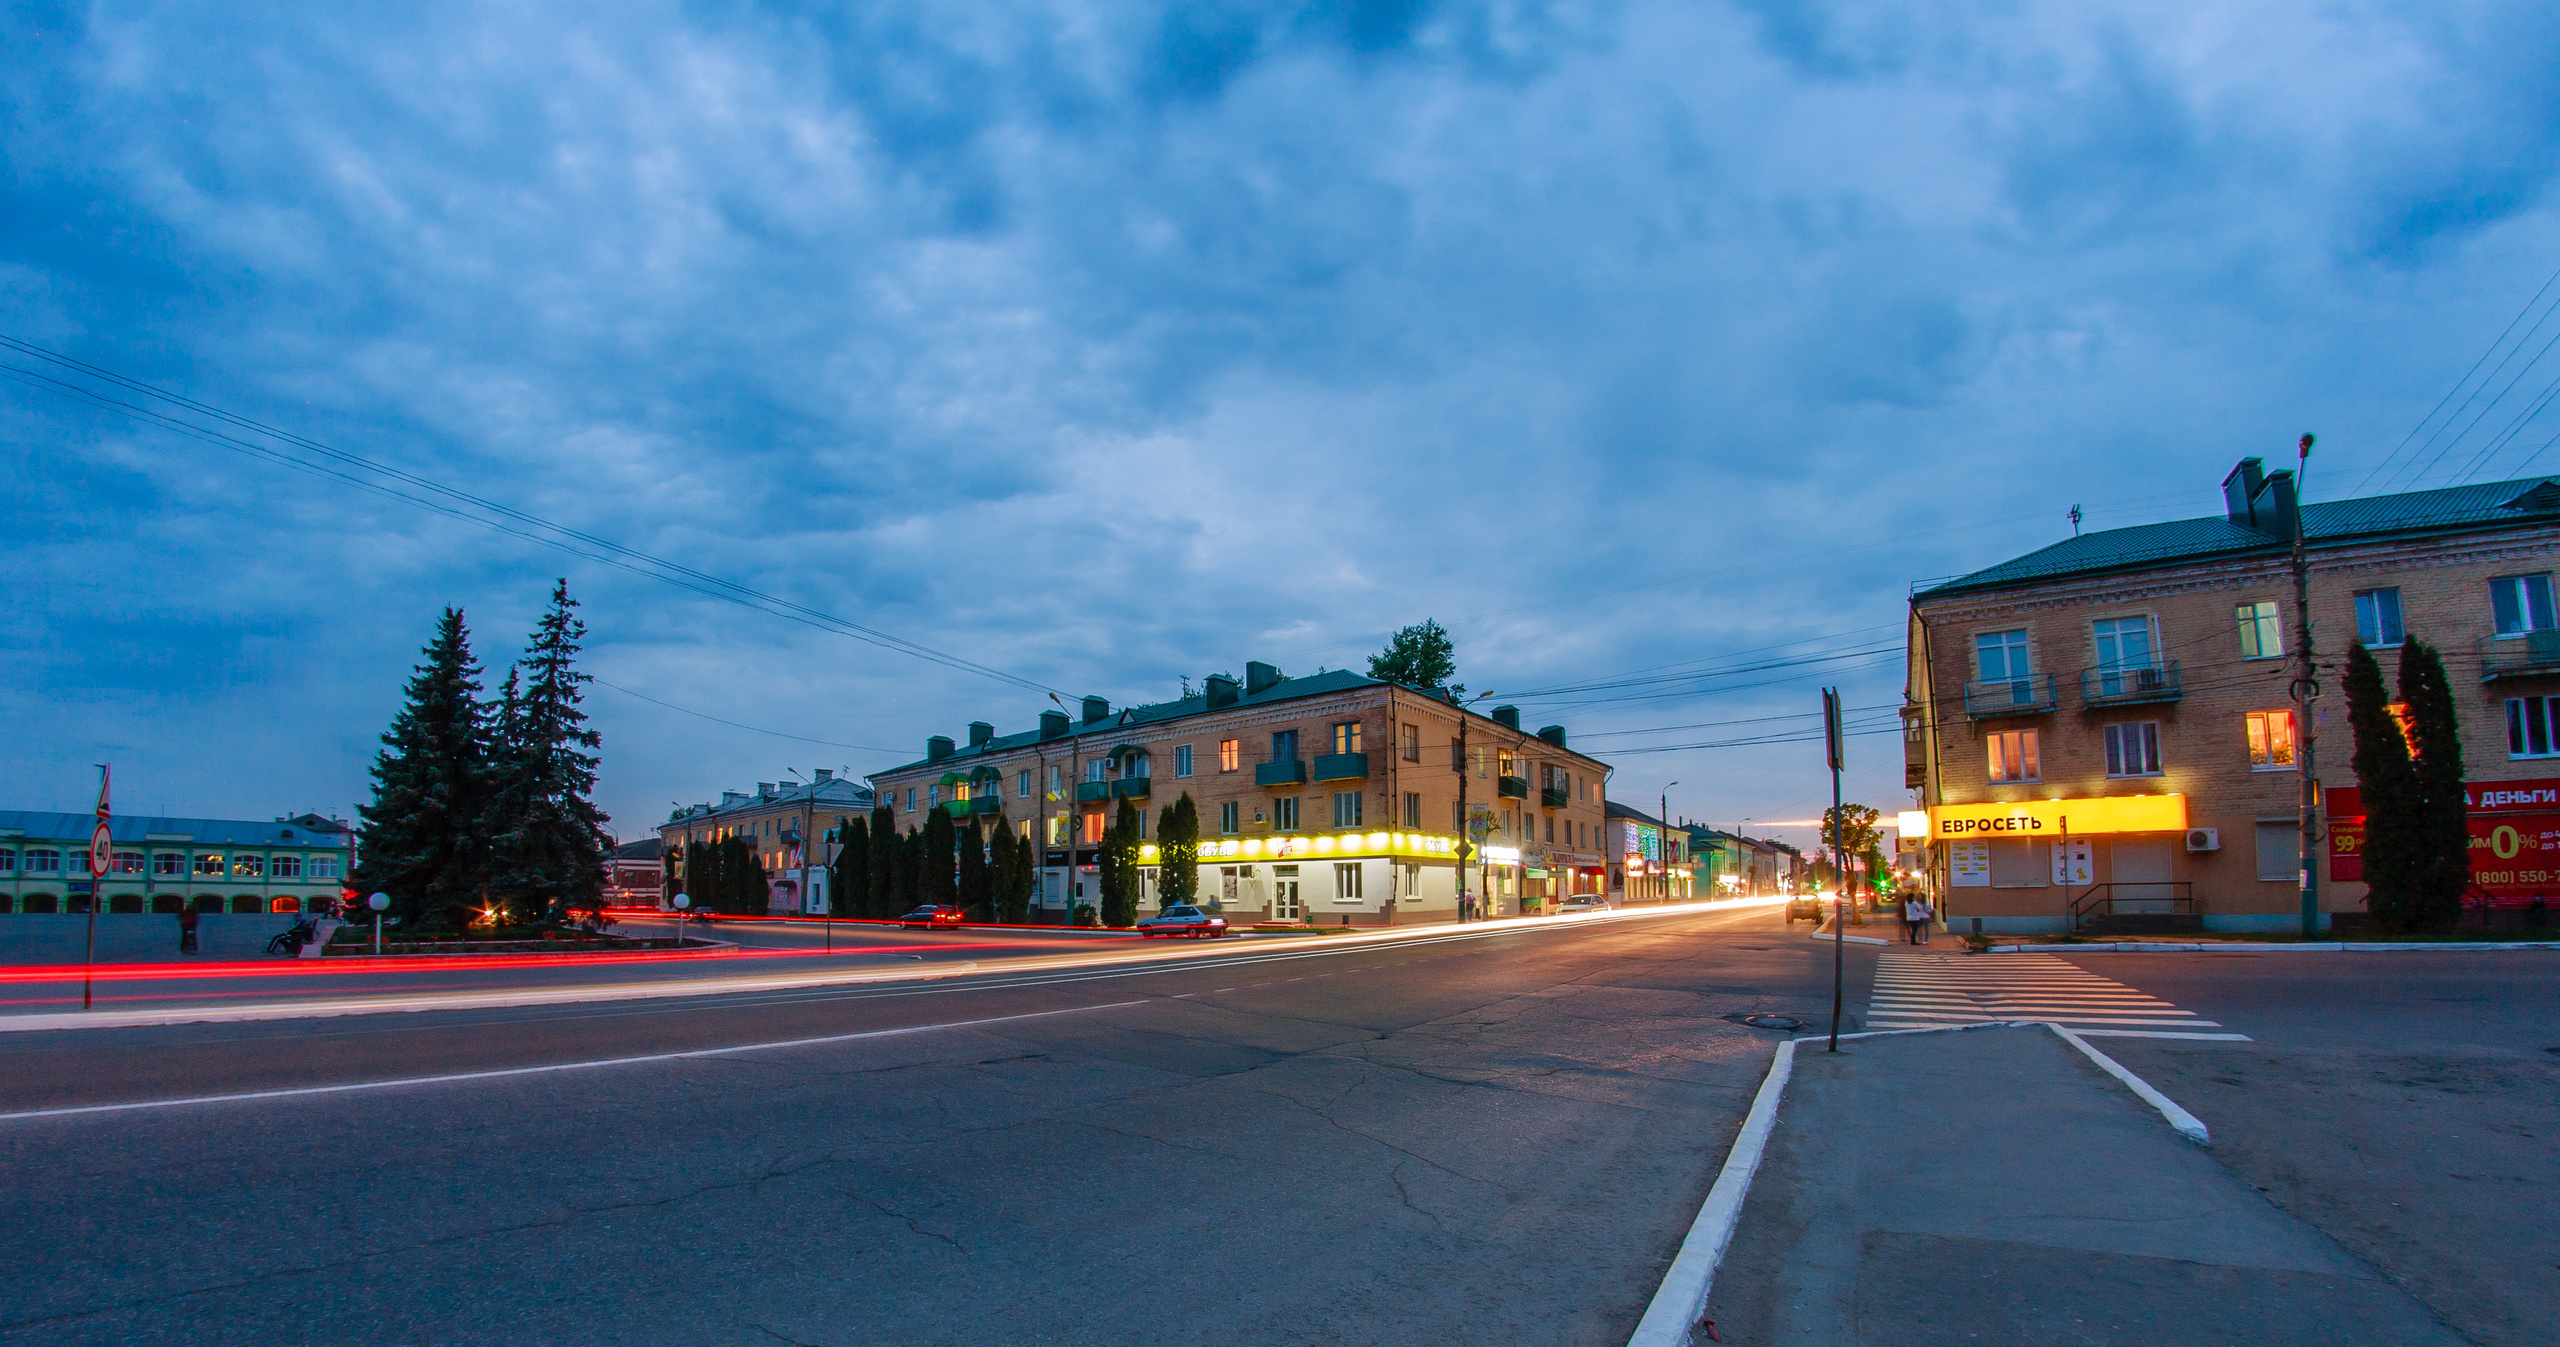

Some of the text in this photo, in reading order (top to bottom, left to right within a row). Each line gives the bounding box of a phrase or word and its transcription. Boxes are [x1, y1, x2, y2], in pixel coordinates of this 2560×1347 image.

[2480, 789, 2556, 807] ДЕНЬГИ
[1942, 816, 2042, 833] ЕВРОСЕТЬ
[2467, 834, 2491, 849] йм
[2540, 831, 2553, 839] до
[96, 840, 108, 861] 40
[1197, 846, 1235, 857] ОБУВЬ
[1425, 839, 1451, 853] ОБУВЬ
[2541, 842, 2554, 850] до
[2476, 870, 2514, 884] (800)
